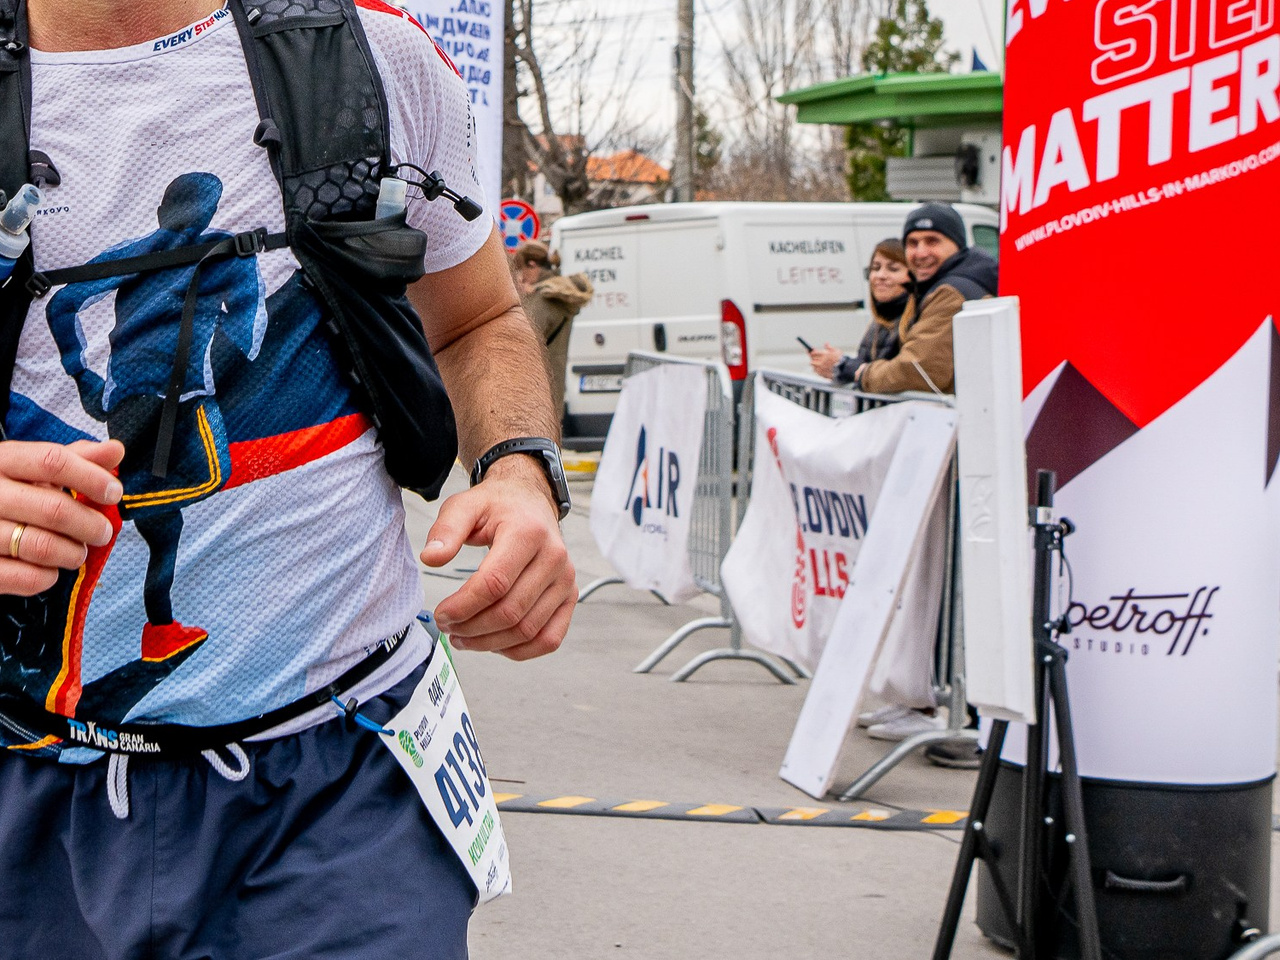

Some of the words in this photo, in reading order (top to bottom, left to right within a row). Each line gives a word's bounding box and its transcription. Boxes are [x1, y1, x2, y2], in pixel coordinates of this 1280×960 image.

[152, 27, 194, 52] EVERY
[194, 16, 216, 36] STEP
[999, 33, 1280, 235] MATTER
[35, 205, 70, 217] RKOVO
[574, 246, 625, 262] KACHEL
[1073, 637, 1150, 656] STUDIO
[119, 731, 145, 744] GRAN
[120, 741, 162, 753] CANARIA
